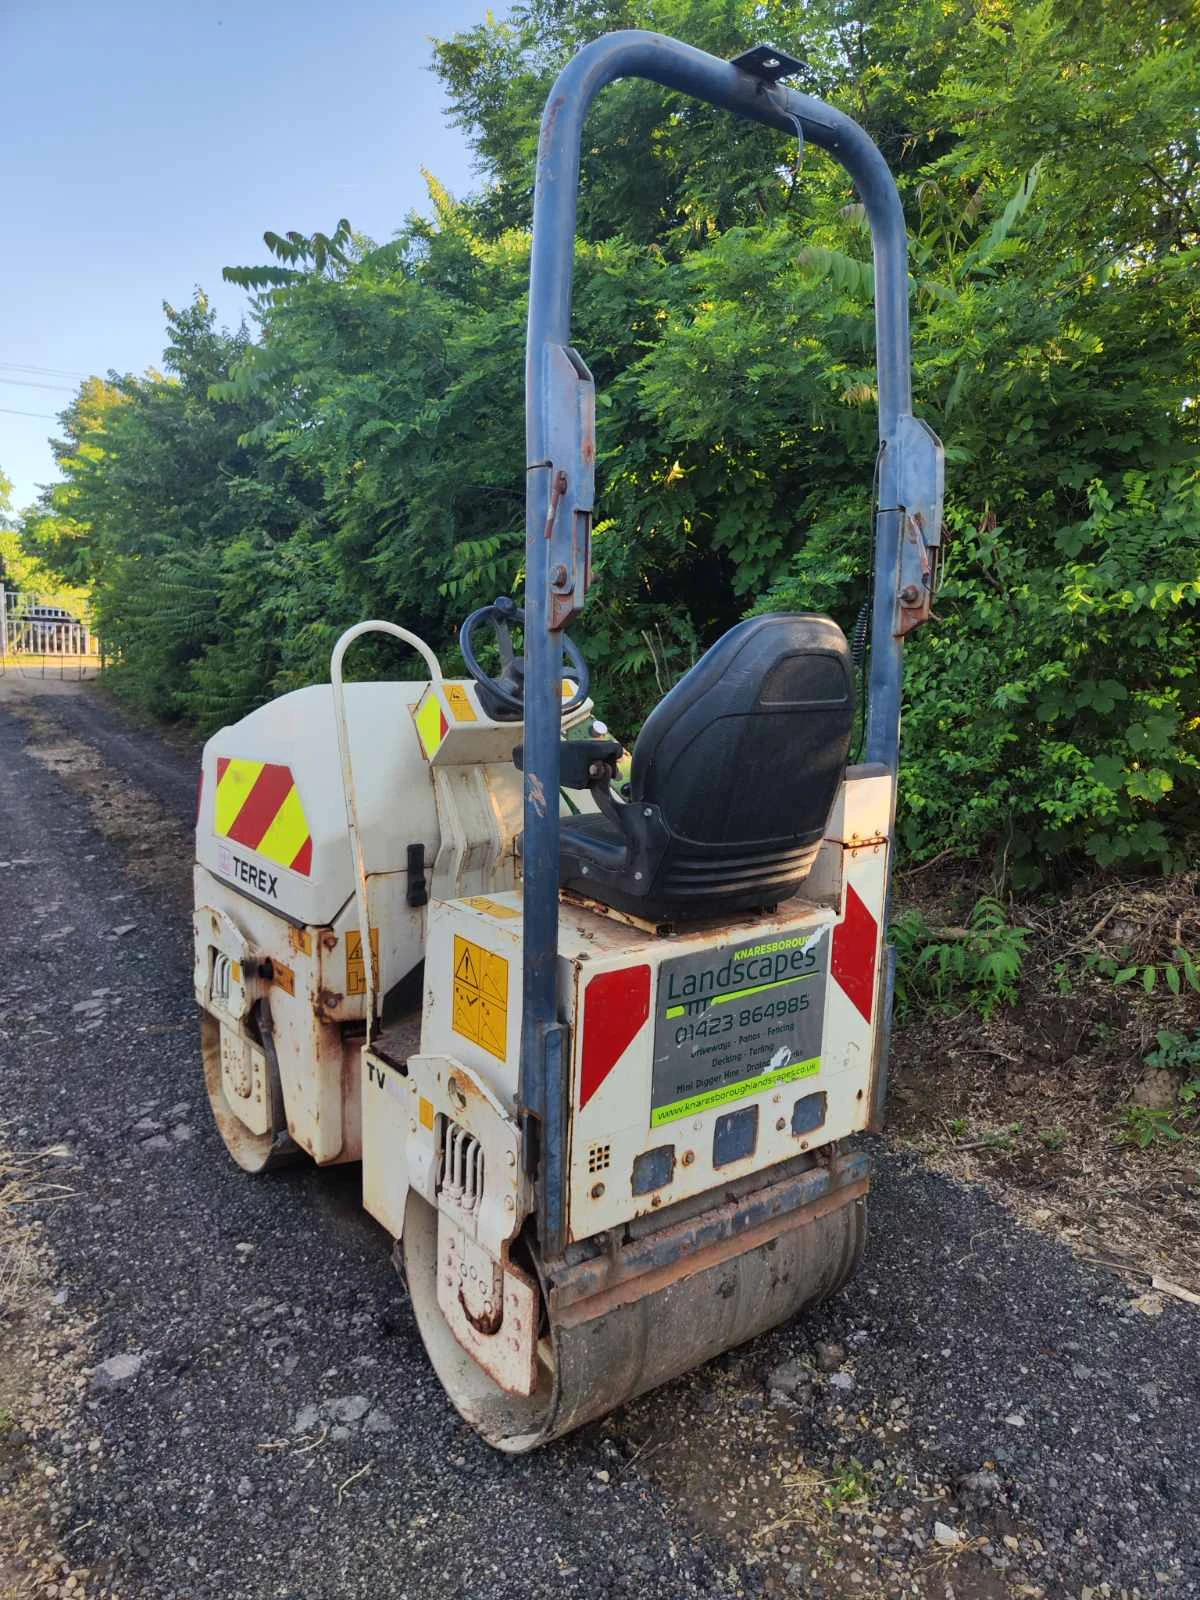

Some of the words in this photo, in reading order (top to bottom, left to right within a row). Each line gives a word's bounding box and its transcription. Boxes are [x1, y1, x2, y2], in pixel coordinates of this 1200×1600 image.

[233, 856, 278, 899] TEREX
[734, 934, 814, 961] KNARESBOROU
[668, 947, 816, 1000] Landscapes
[675, 1013, 734, 1045] 01423
[739, 993, 810, 1028] 864985
[366, 1060, 386, 1089] TV
[695, 1072, 722, 1090] Digger
